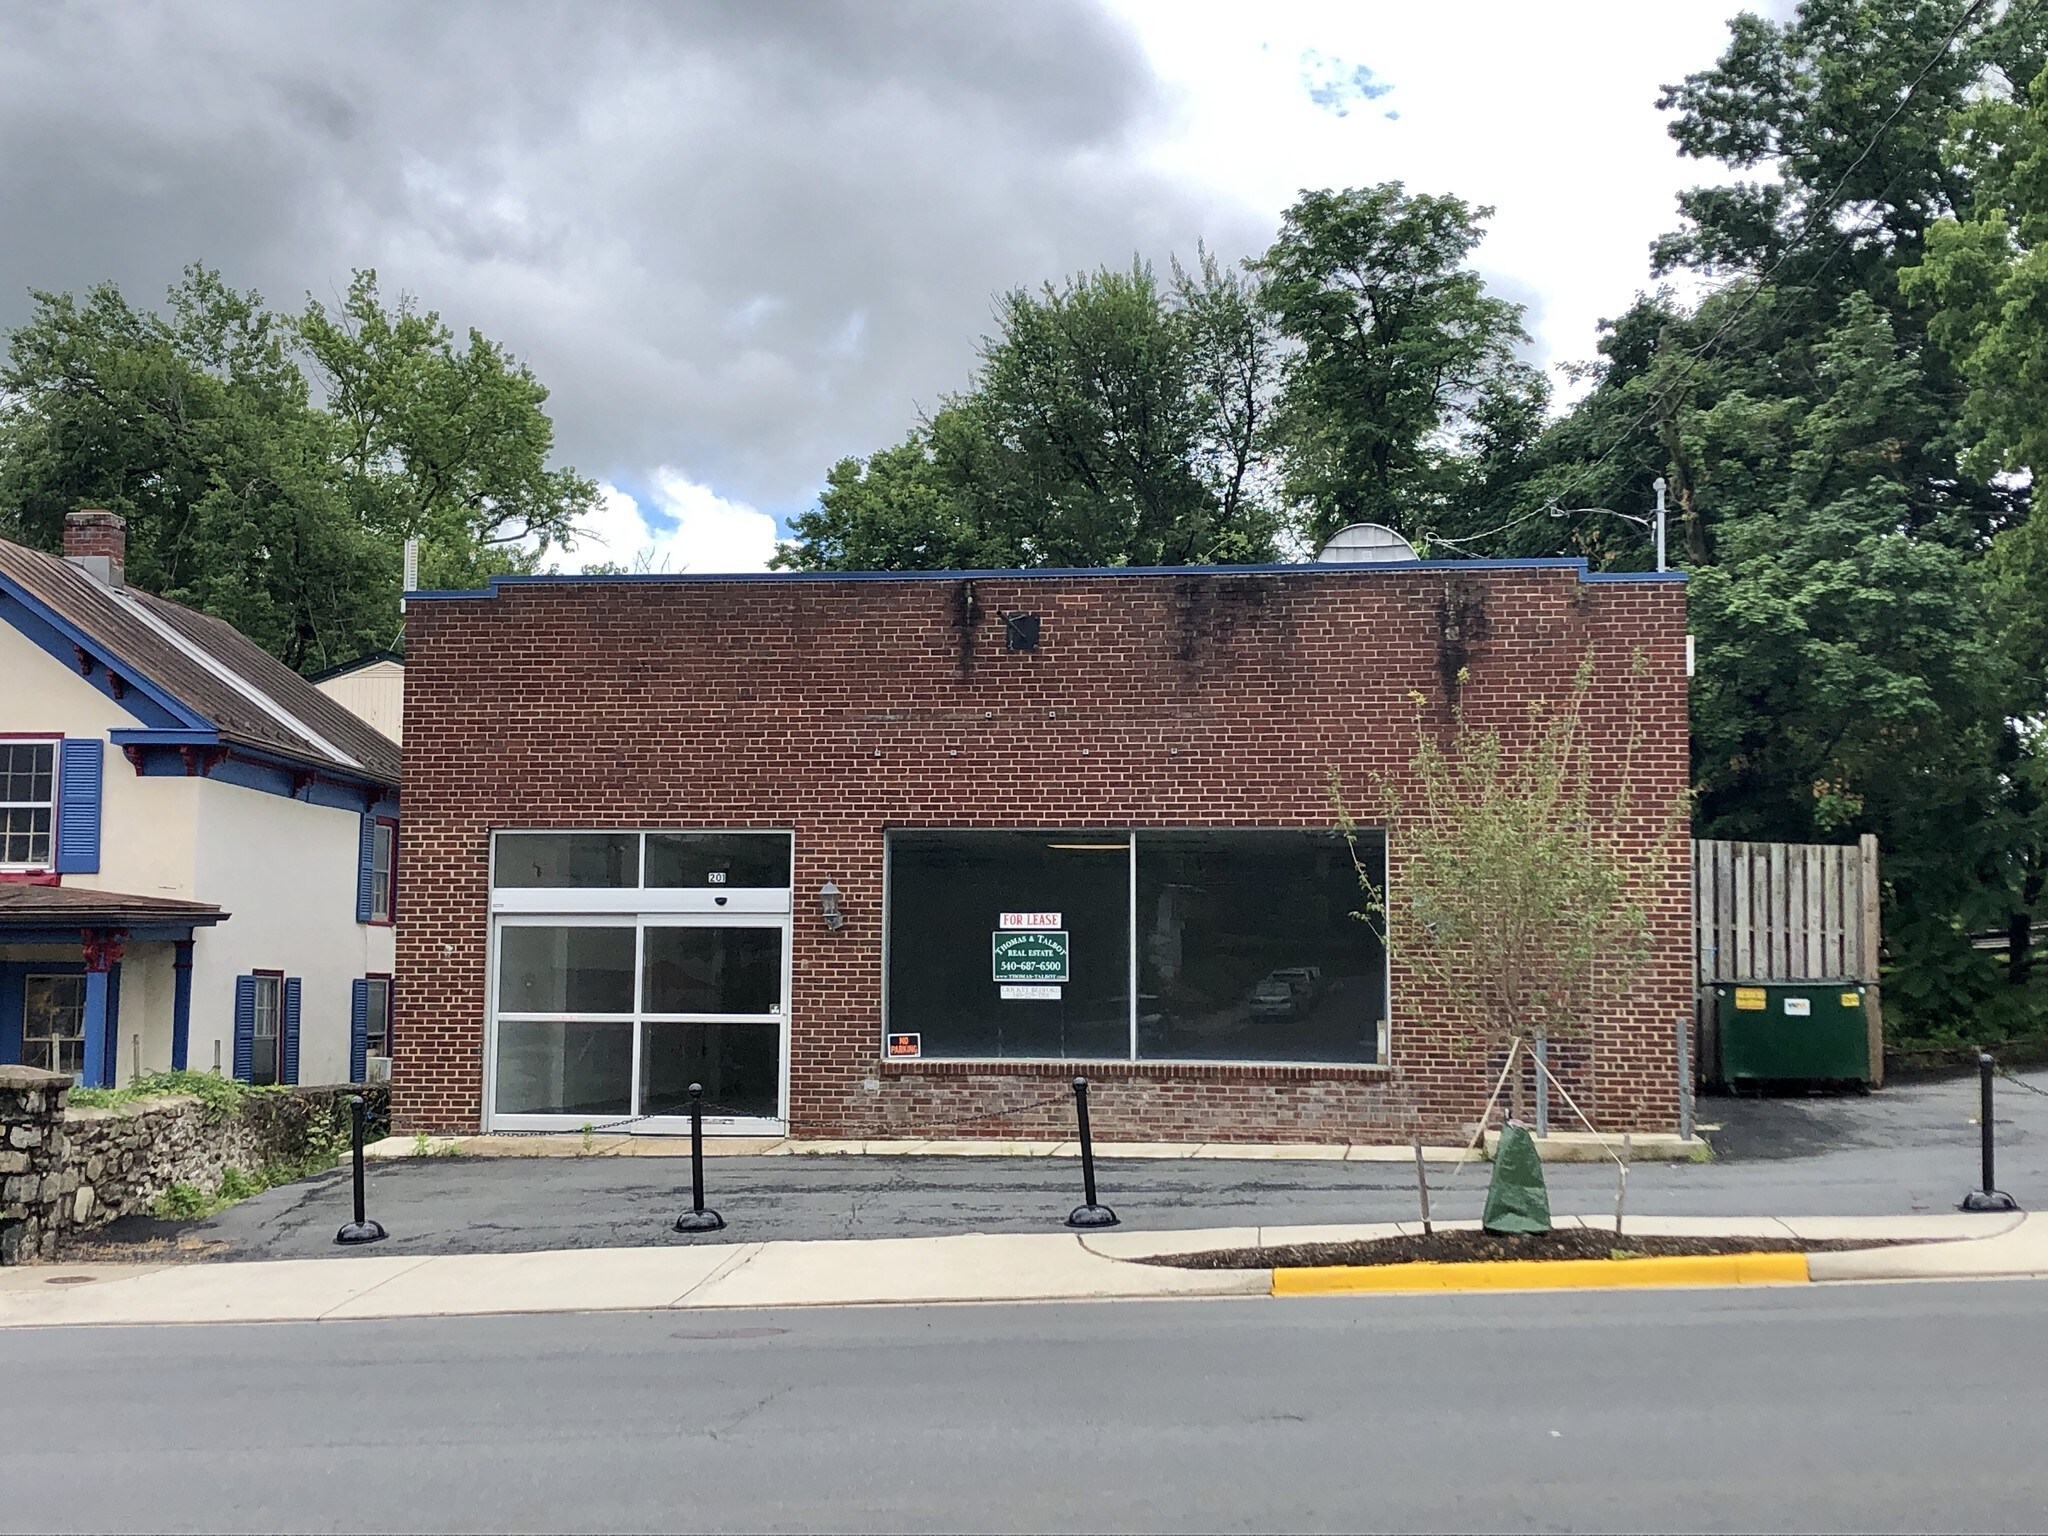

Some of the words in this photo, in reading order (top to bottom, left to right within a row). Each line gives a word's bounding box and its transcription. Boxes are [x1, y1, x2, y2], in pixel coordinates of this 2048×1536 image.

[709, 873, 725, 882] 201
[1003, 914, 1023, 925] FOR
[1027, 914, 1058, 925] LEASE
[995, 935, 1027, 955] THOMAS
[1037, 934, 1067, 956] TALBOT
[1007, 949, 1027, 957] REAL
[1028, 949, 1054, 957] ESTATE
[1000, 961, 1061, 971] 540-687-6500
[899, 1036, 909, 1045] NO
[891, 1045, 917, 1054] PARKING
